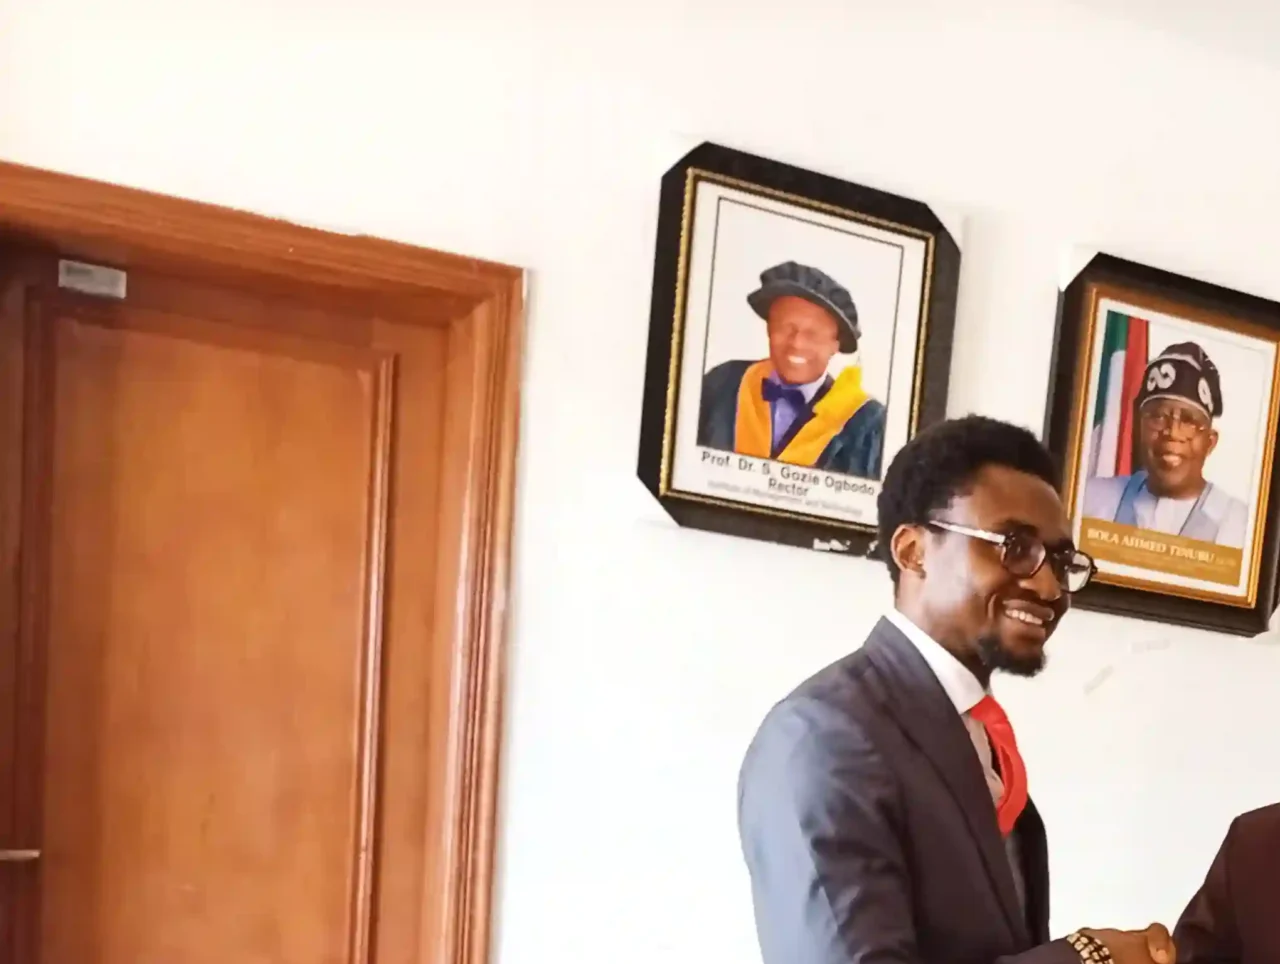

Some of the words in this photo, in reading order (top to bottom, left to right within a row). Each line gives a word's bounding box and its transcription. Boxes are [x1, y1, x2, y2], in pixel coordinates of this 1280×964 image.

[701, 451, 731, 467] Prof.
[738, 458, 756, 472] Dr.
[780, 466, 820, 485] Gozie
[824, 476, 875, 496] Ogbodo
[768, 478, 810, 497] Rector
[1122, 535, 1167, 553] AHMED
